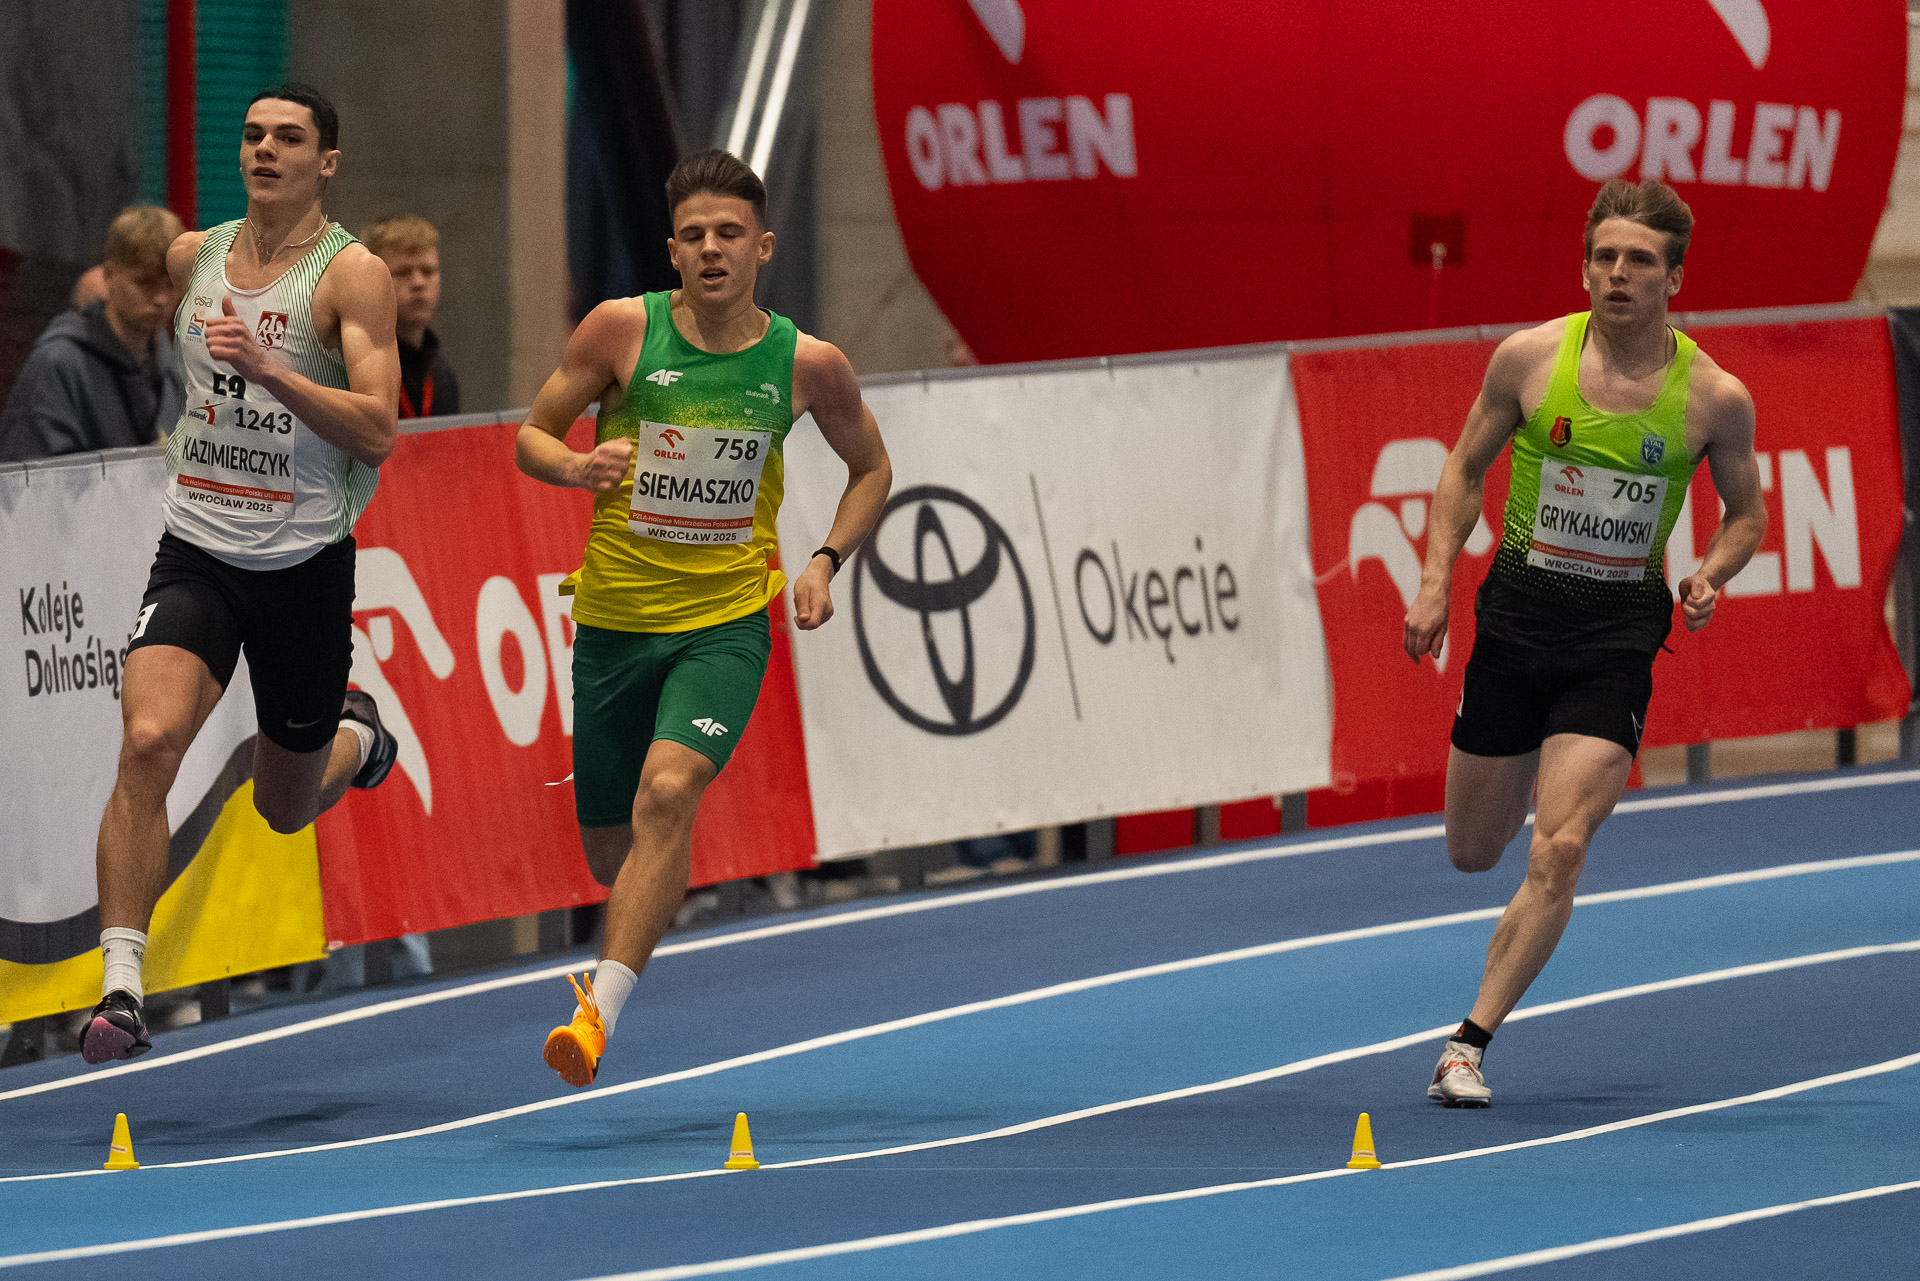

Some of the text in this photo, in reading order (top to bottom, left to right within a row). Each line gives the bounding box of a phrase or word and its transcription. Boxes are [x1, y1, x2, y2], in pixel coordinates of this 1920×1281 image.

[904, 92, 1138, 191] ORLEN
[1563, 92, 1842, 192] ORLEN
[646, 369, 683, 387] 4F
[234, 406, 292, 434] 1243
[182, 435, 291, 477] KAZIMIERCZYK
[654, 449, 686, 461] ORLEN
[714, 437, 759, 461] 758
[638, 471, 754, 504] SIEMASZKO
[1554, 483, 1584, 497] ORLEN
[1611, 478, 1658, 504] 705
[188, 491, 274, 513] WROCŁAW 2025
[647, 527, 737, 542] WROCŁAW 2025
[1540, 504, 1652, 545] GRYKAŁOWSKI
[1545, 557, 1629, 578] WROCŁAW 2025
[20, 581, 84, 643] Koleje
[1074, 534, 1239, 666] Okęcie
[691, 717, 729, 737] 4F
